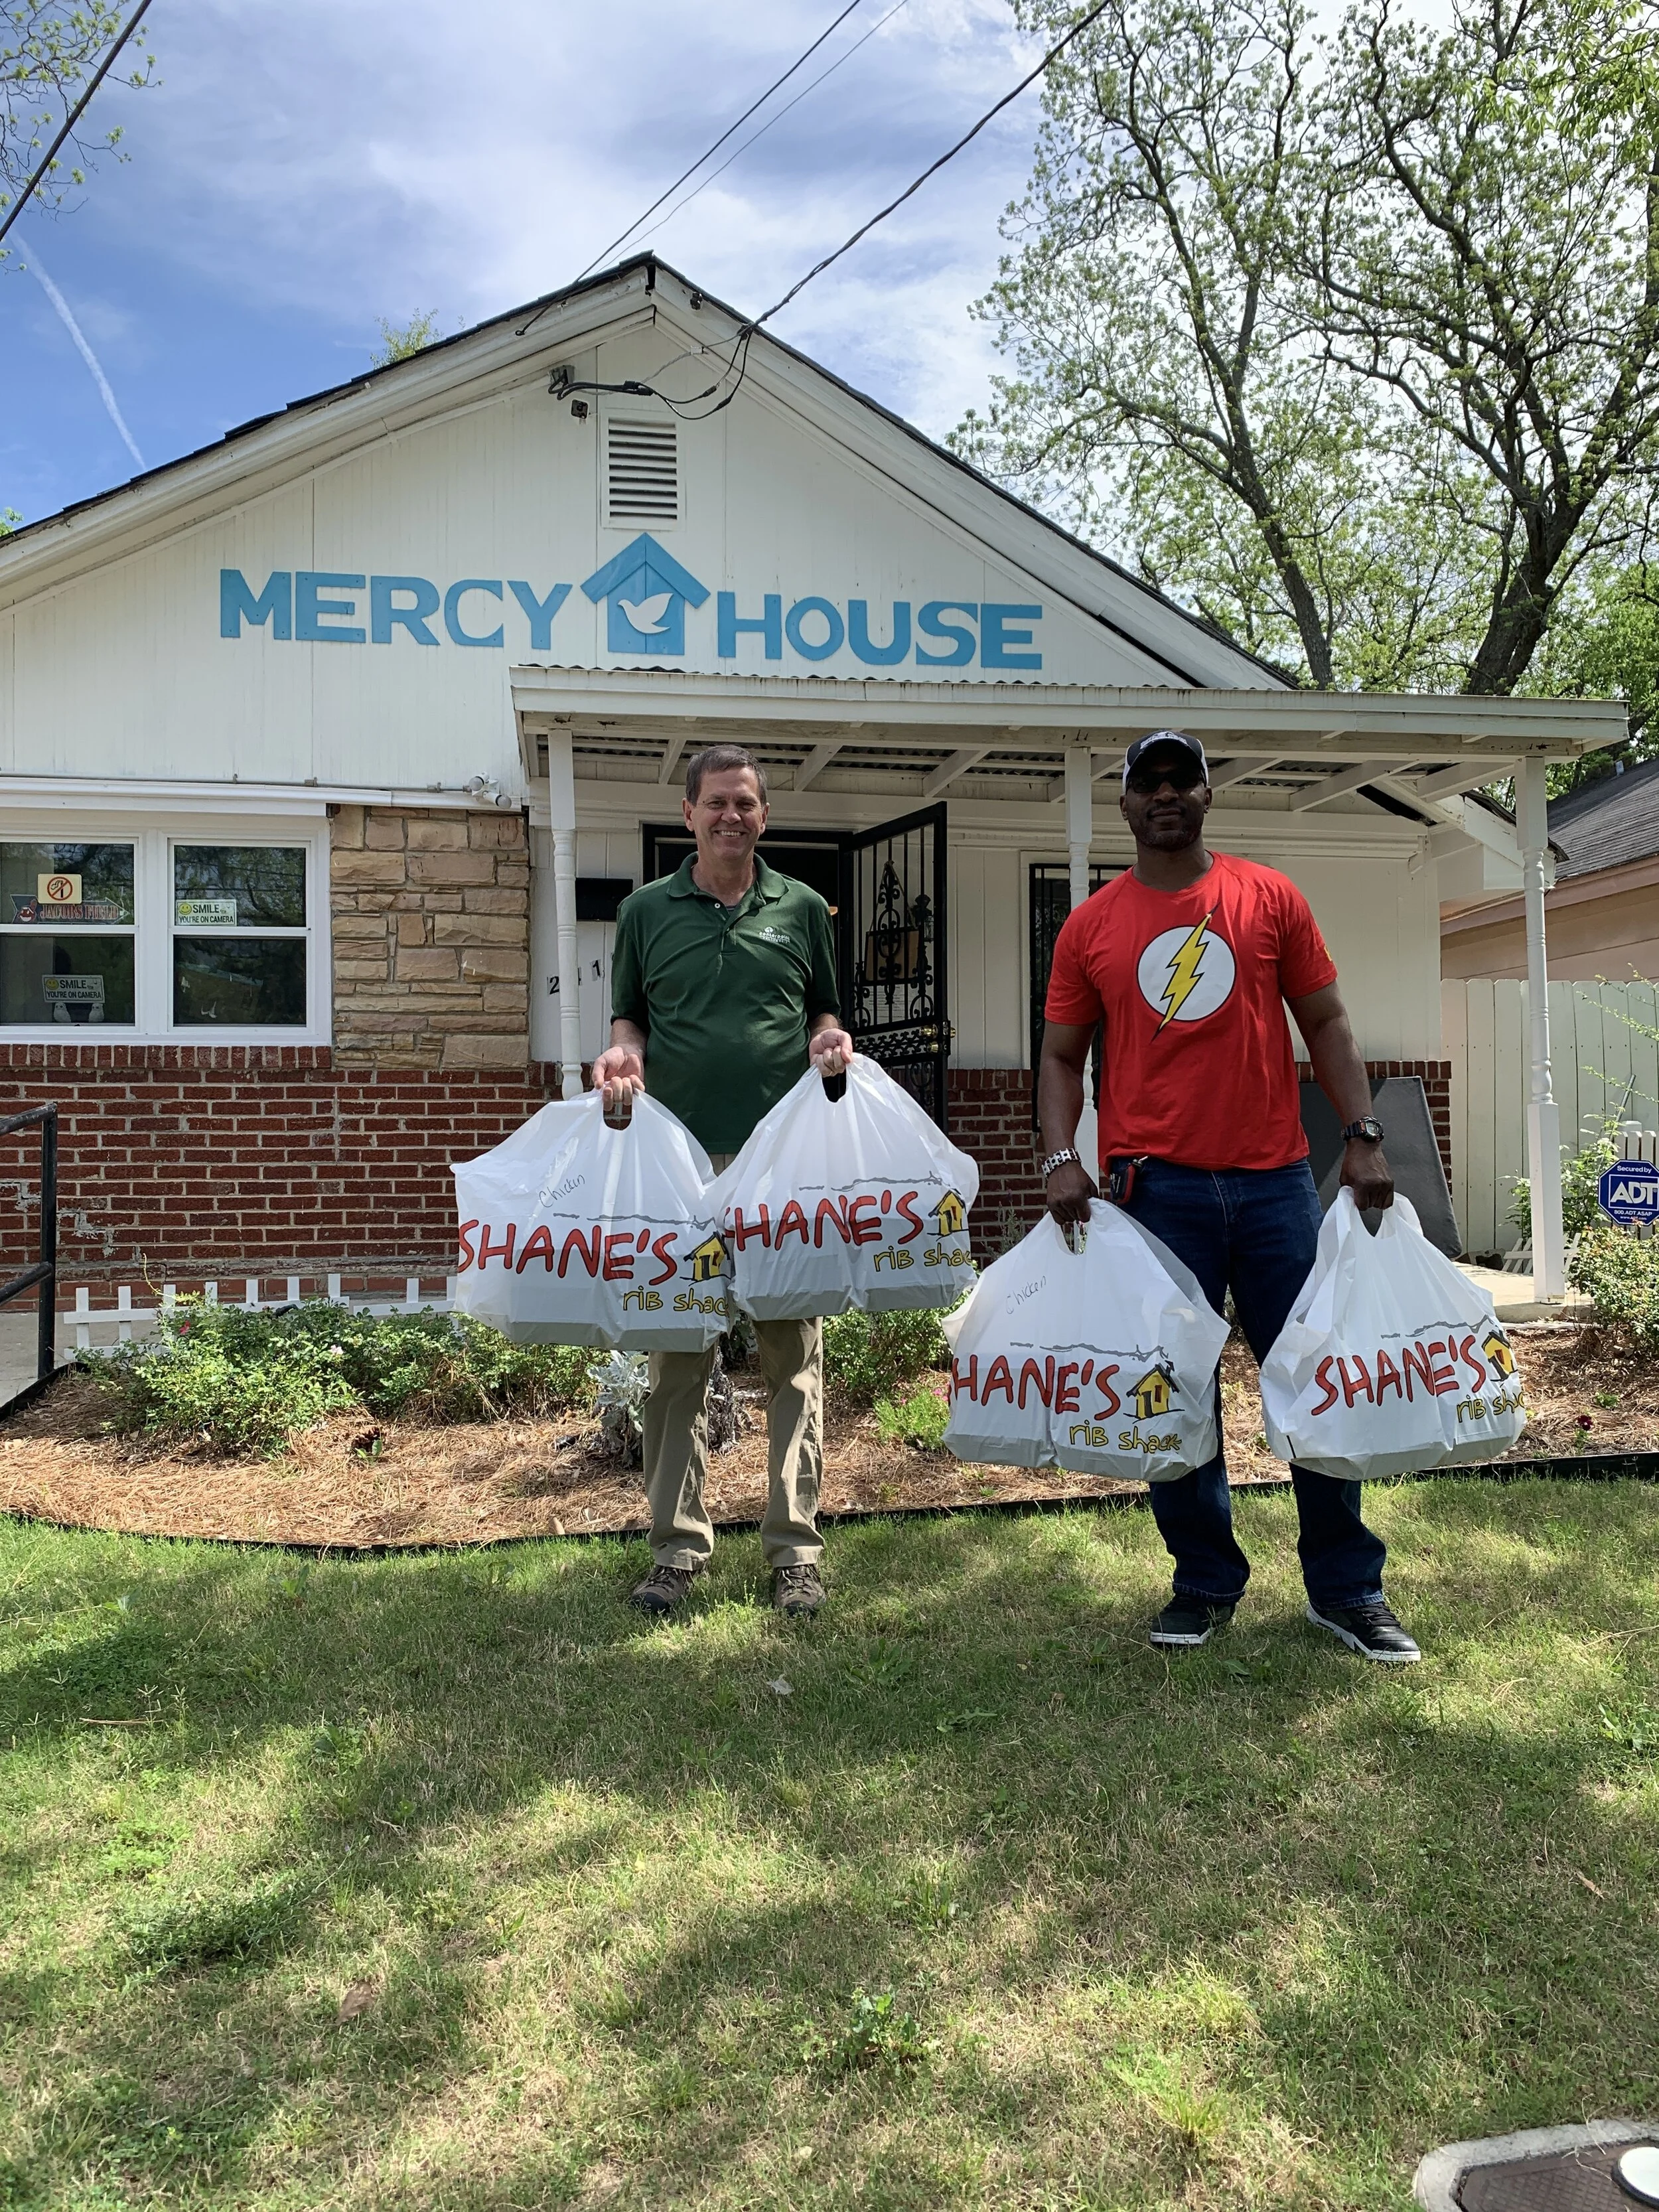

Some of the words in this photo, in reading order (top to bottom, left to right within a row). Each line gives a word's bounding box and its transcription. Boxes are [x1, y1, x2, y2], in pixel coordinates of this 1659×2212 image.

[220, 569, 573, 650] MERCY
[717, 591, 1042, 670] HOUSE
[85, 905, 119, 920] FIELD
[192, 904, 220, 913] SMILE
[60, 980, 86, 989] SMILE
[1610, 1181, 1659, 1205] ADT
[723, 1190, 924, 1251] HANE'S
[457, 1219, 678, 1286] SHANE'S
[674, 1288, 728, 1315] shac
[1006, 1275, 1046, 1314] Chicken
[948, 1355, 1121, 1421] HANE'S
[1311, 1335, 1486, 1416] SHANE'S
[1119, 1426, 1182, 1454] shack
